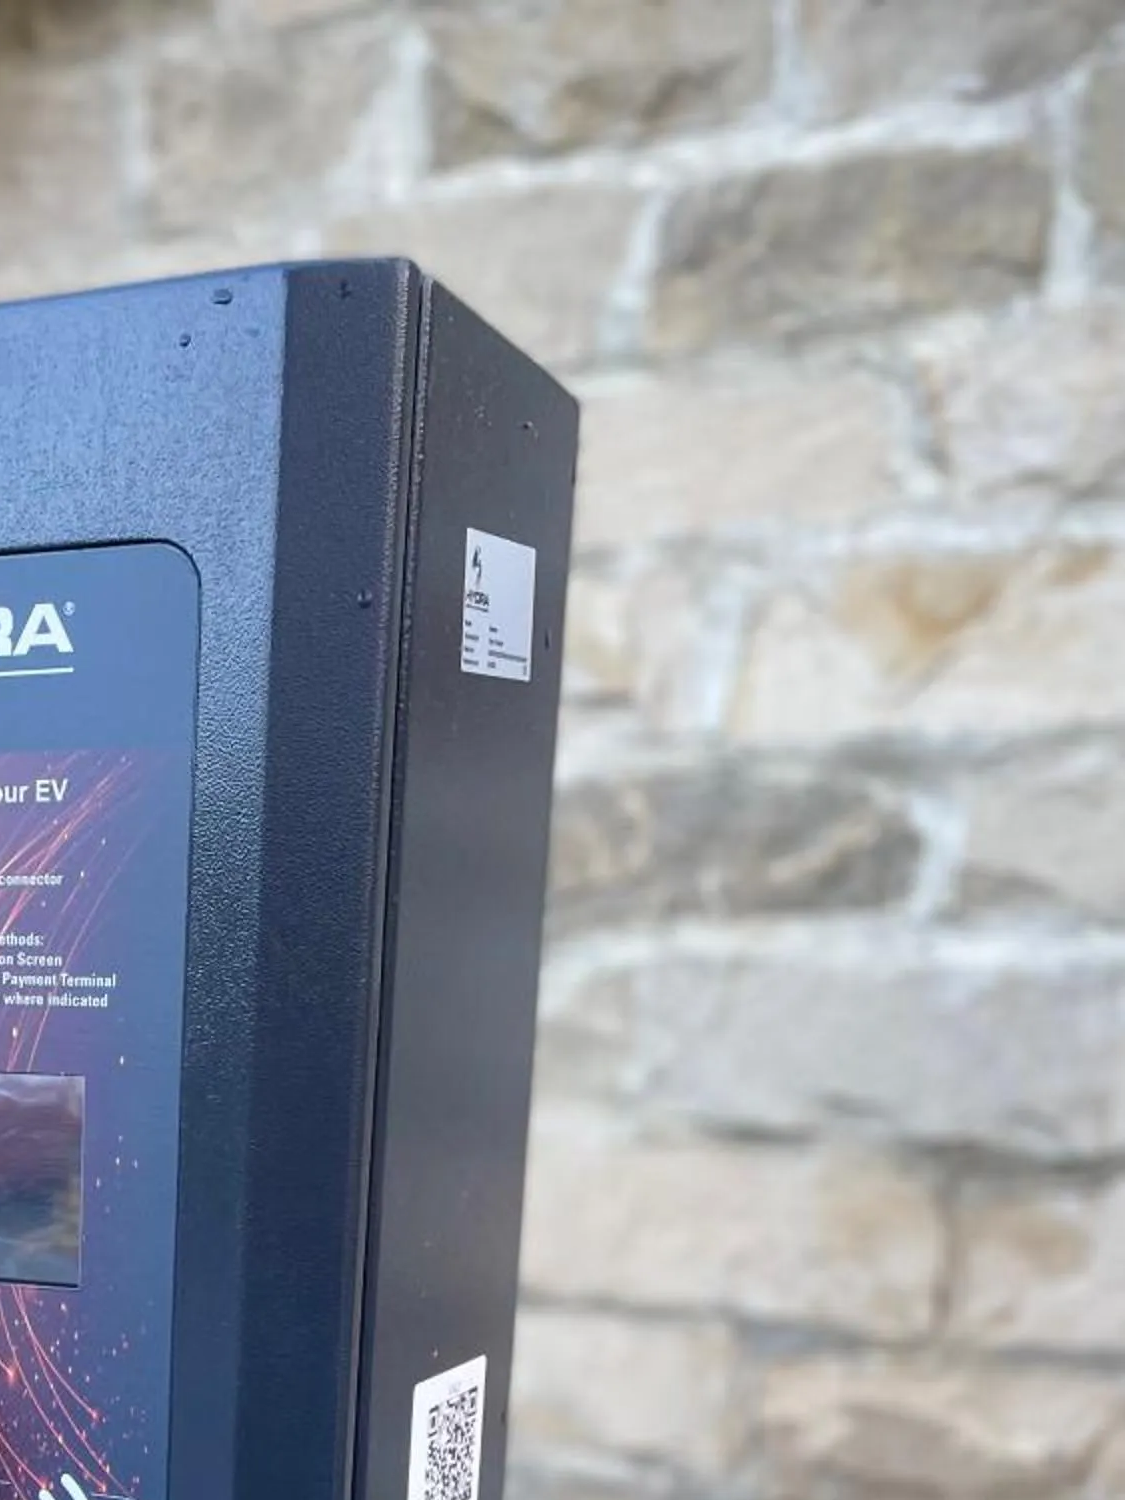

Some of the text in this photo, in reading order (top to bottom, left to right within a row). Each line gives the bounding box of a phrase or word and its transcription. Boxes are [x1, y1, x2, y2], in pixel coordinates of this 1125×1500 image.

[35, 778, 69, 803] EV
[17, 952, 63, 968] Screen
[2, 972, 57, 988] Payment
[60, 972, 117, 988] Terminal
[2, 992, 44, 1005] where
[48, 992, 109, 1008] indicated
